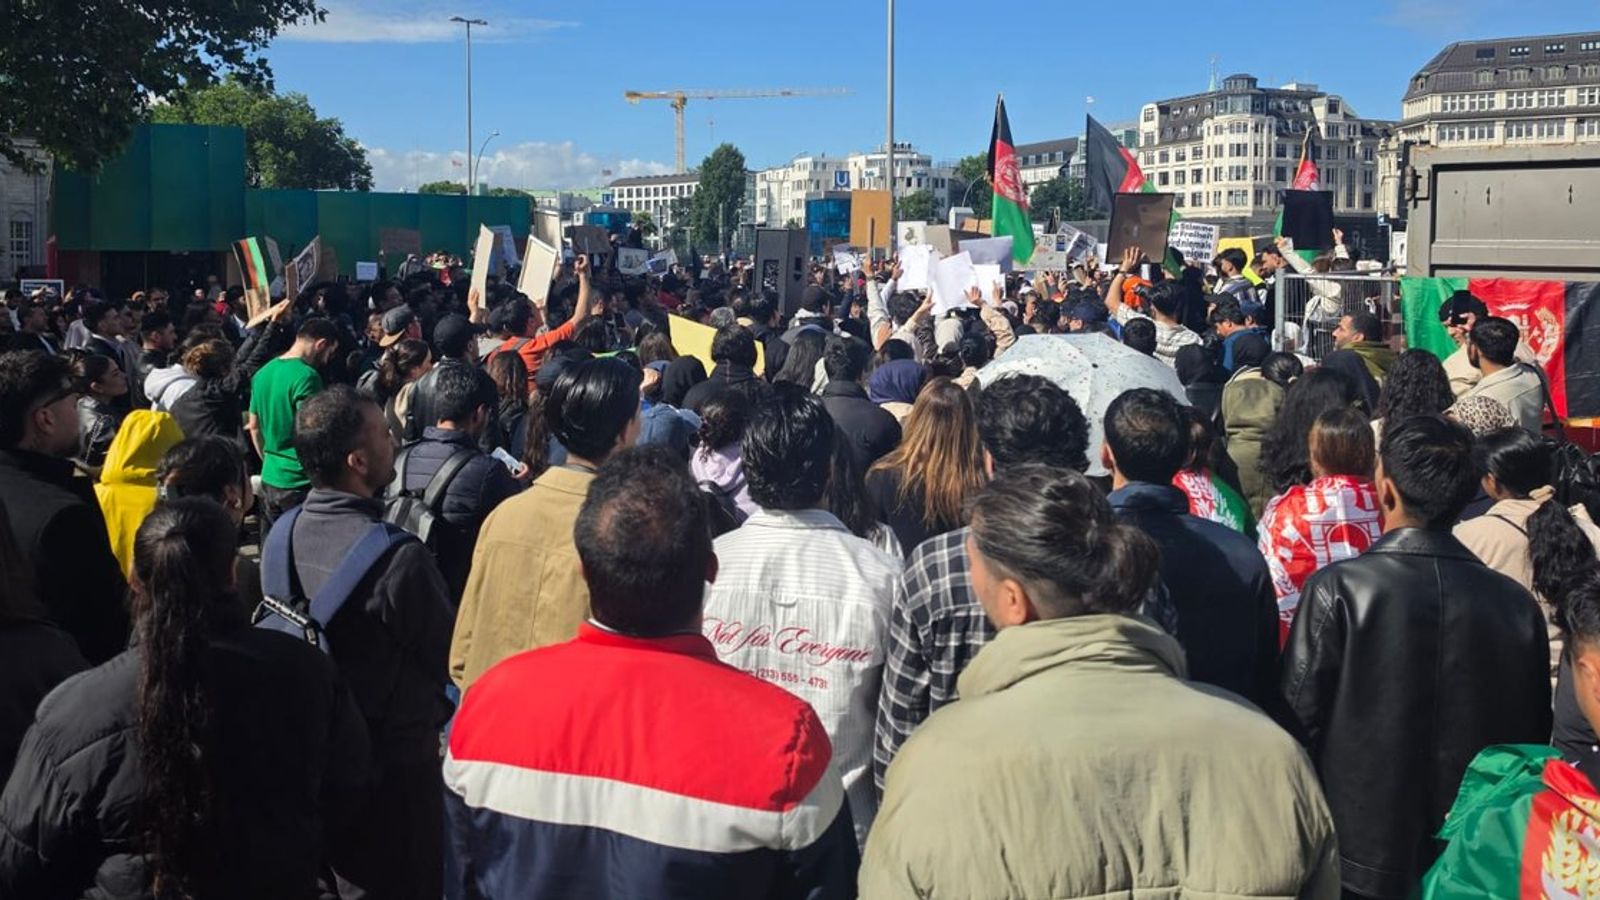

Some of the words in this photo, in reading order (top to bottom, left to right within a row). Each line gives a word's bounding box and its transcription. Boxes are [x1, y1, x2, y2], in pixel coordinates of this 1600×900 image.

[836, 172, 847, 186] U
[703, 617, 742, 645] Not
[721, 624, 772, 656] for
[775, 627, 870, 667] Everyone
